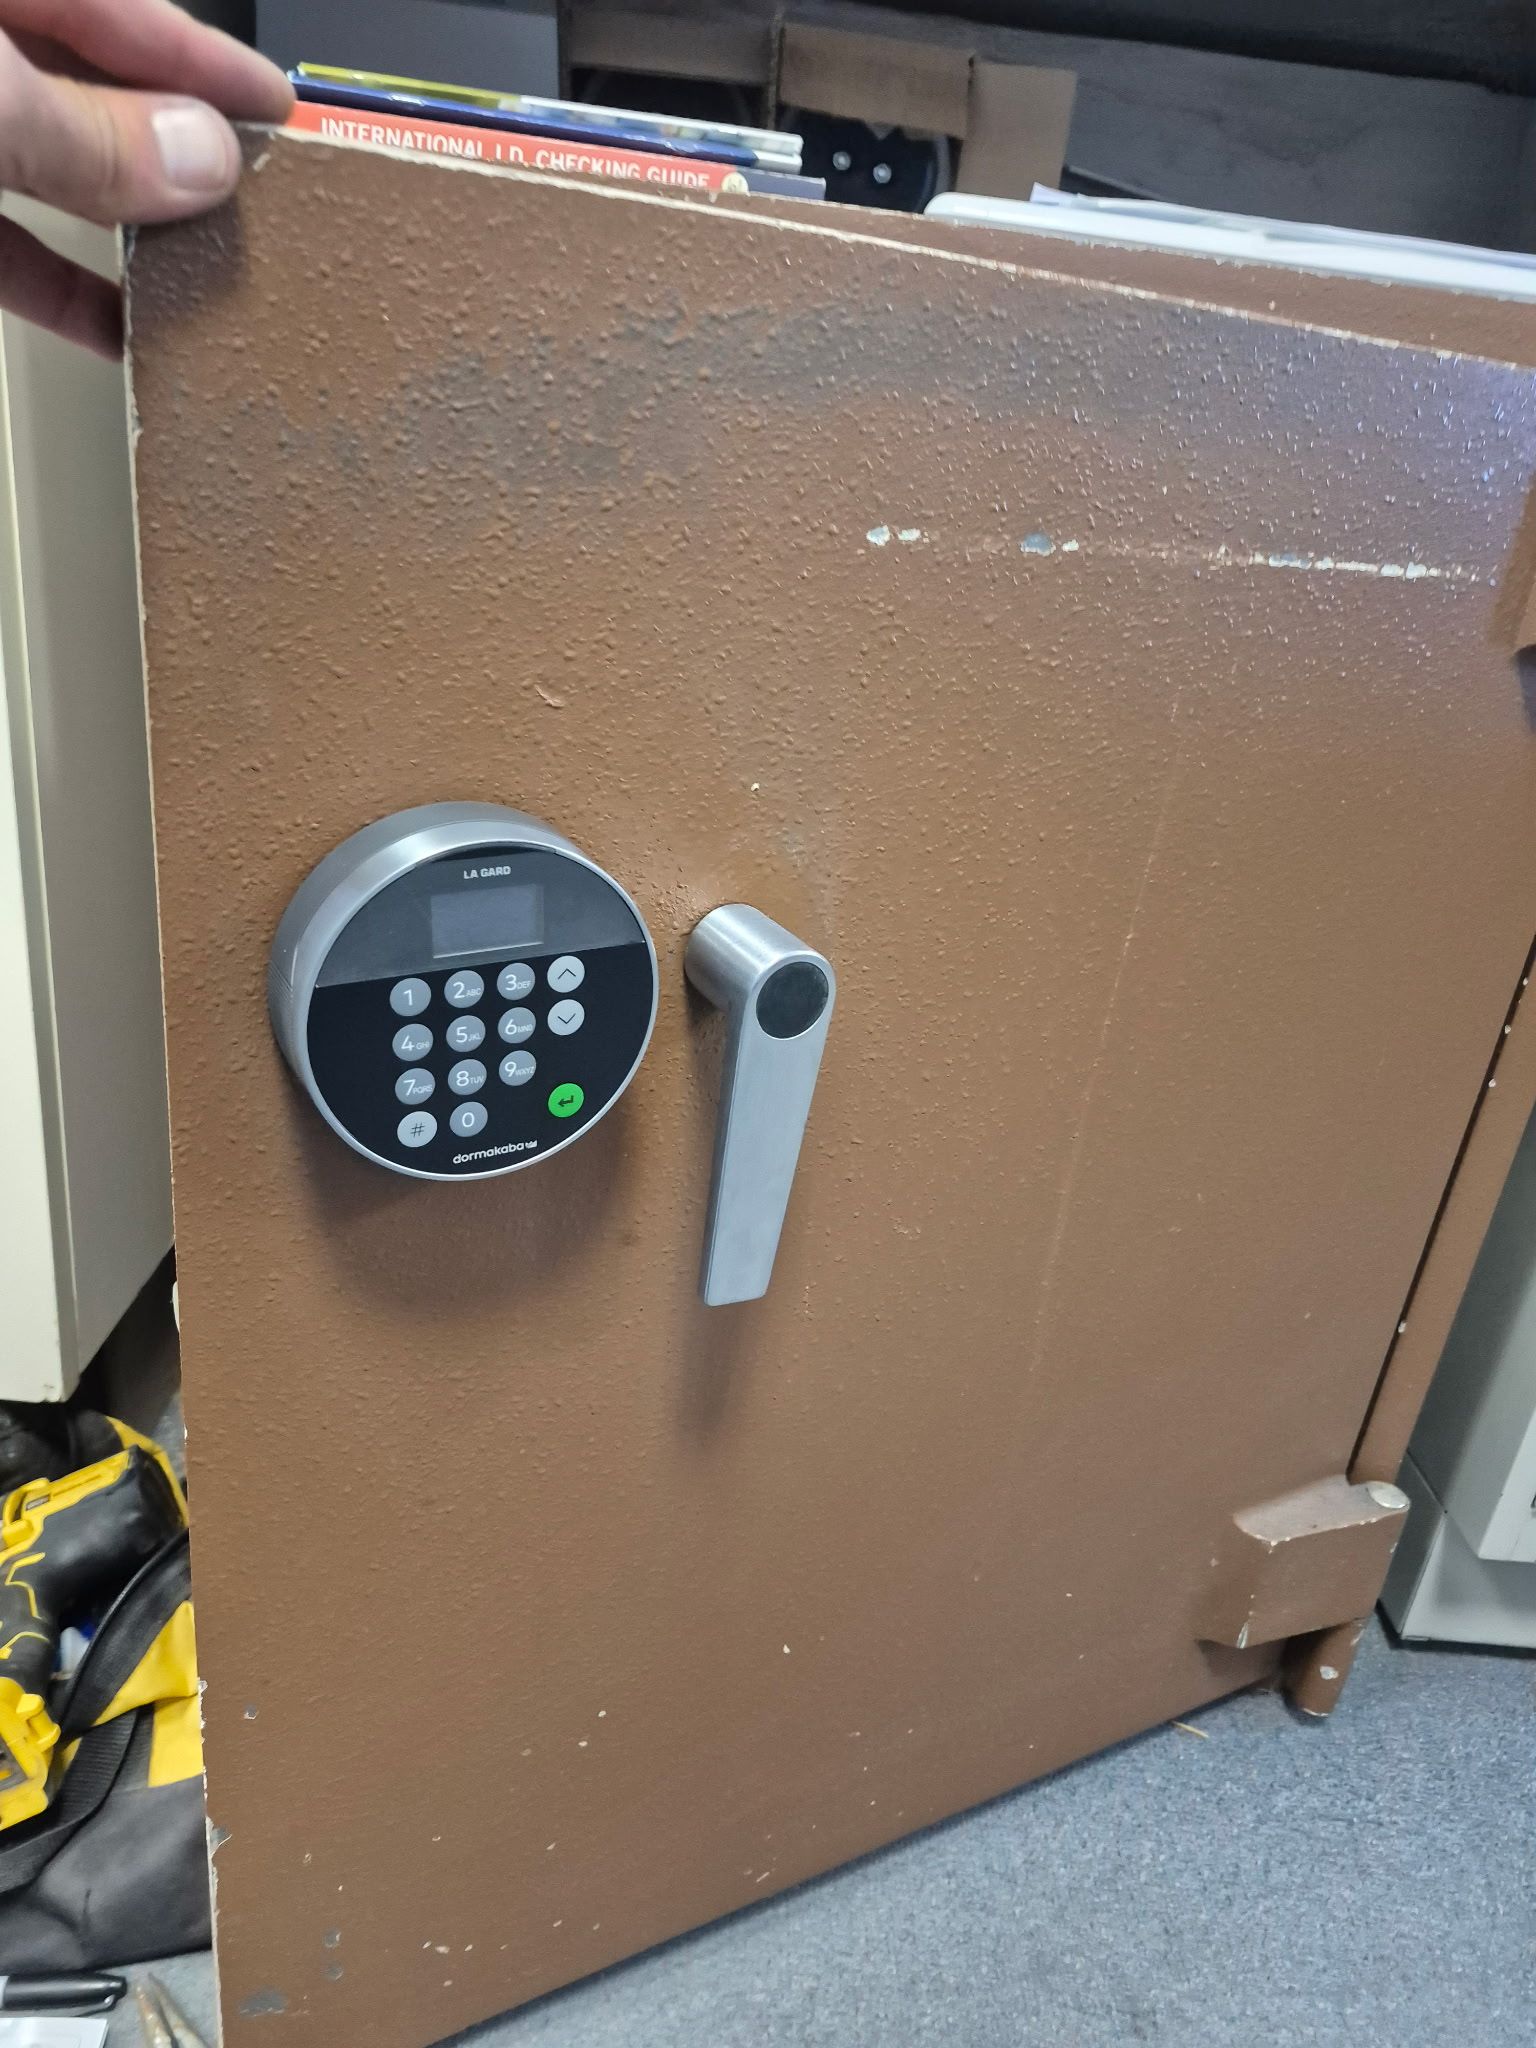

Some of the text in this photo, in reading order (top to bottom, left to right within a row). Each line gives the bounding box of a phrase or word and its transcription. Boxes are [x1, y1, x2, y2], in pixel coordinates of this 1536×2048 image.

[321, 117, 483, 159] INTERNATIONAL
[536, 149, 640, 180] CHECKING
[647, 166, 710, 189] GUIDE
[463, 865, 512, 880] LA GARD
[453, 981, 465, 999] 2
[505, 974, 517, 991] 3
[403, 989, 413, 1006] 1
[456, 1026, 468, 1043] 5
[505, 1019, 517, 1035] 6
[400, 1035, 415, 1052] 4
[504, 1061, 517, 1077] 9
[456, 1070, 470, 1087] 8
[403, 1079, 416, 1096] 7
[461, 1112, 475, 1128] 0
[410, 1122, 425, 1138] #
[452, 1142, 525, 1164] dormakaba
